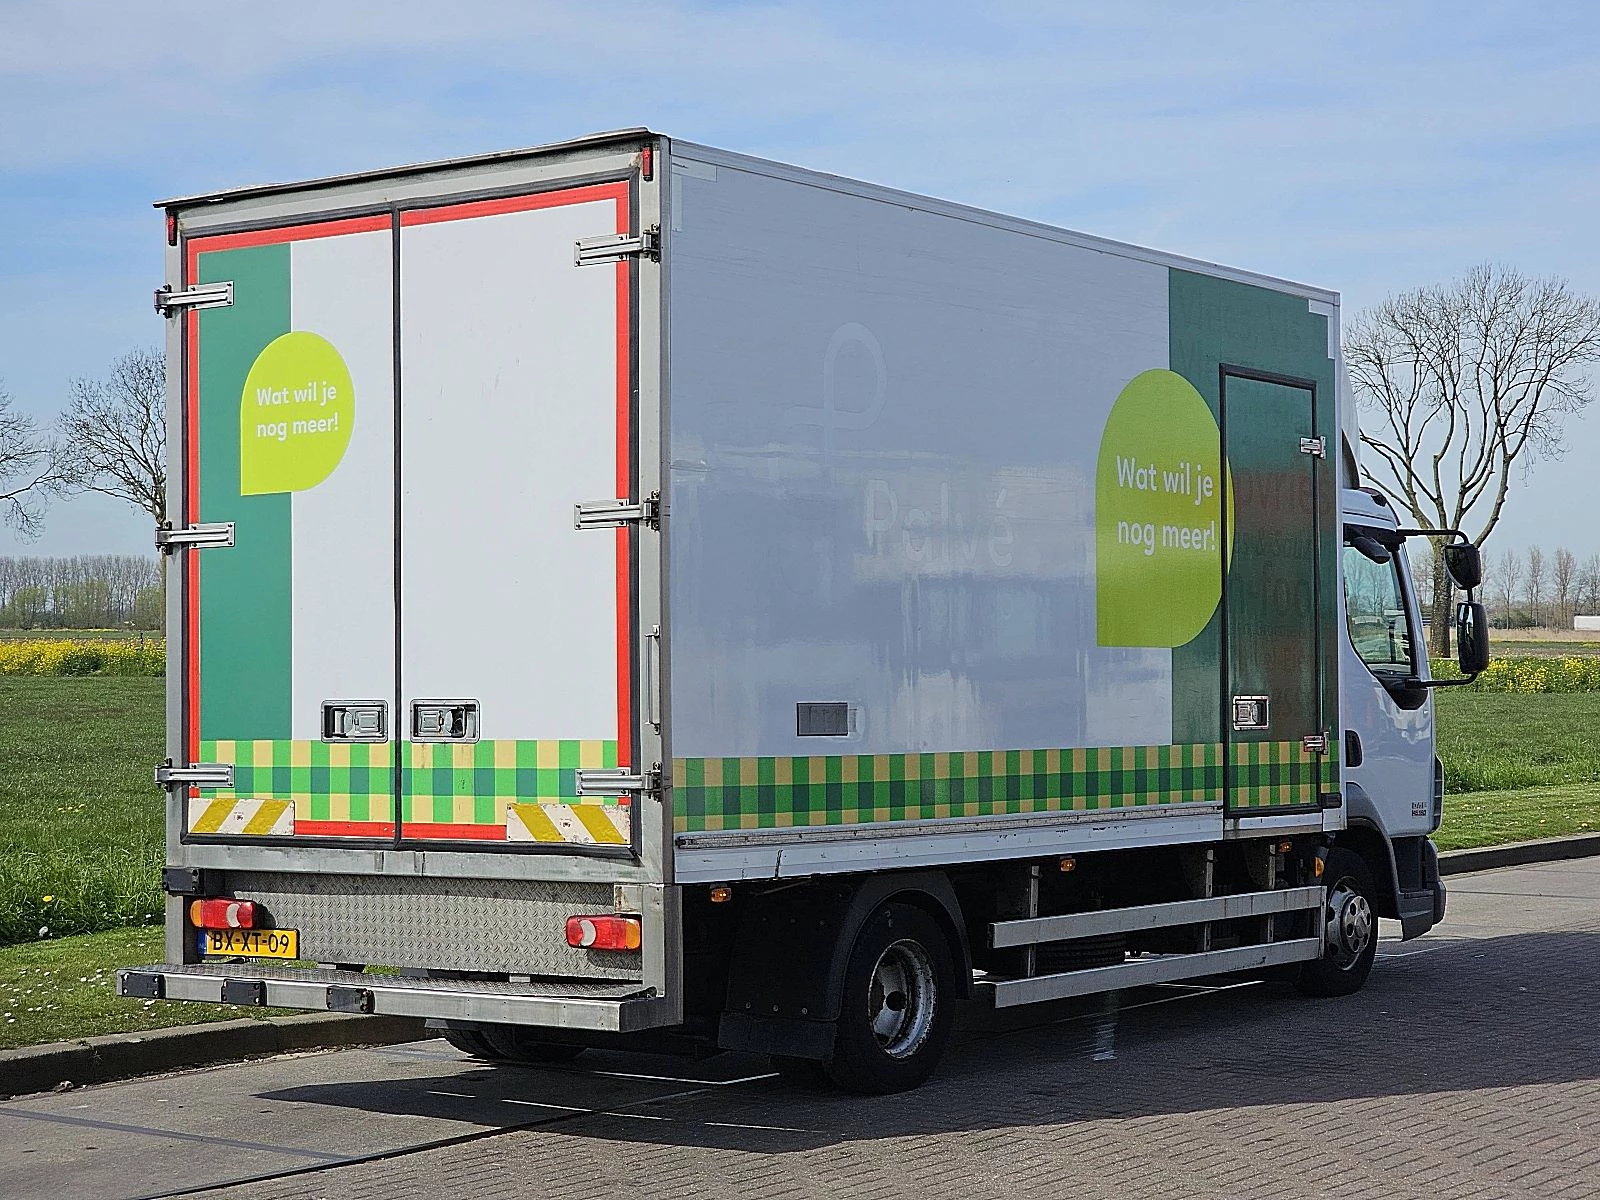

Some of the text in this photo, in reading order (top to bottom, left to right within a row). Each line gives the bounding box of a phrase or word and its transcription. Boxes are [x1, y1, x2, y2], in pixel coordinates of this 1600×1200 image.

[256, 381, 337, 406] Wat wil je
[256, 412, 339, 441] nog meer!
[1116, 455, 1214, 506] Wat wil je
[1117, 520, 1216, 556] nog meer!
[213, 930, 290, 954] BX-XT-09
